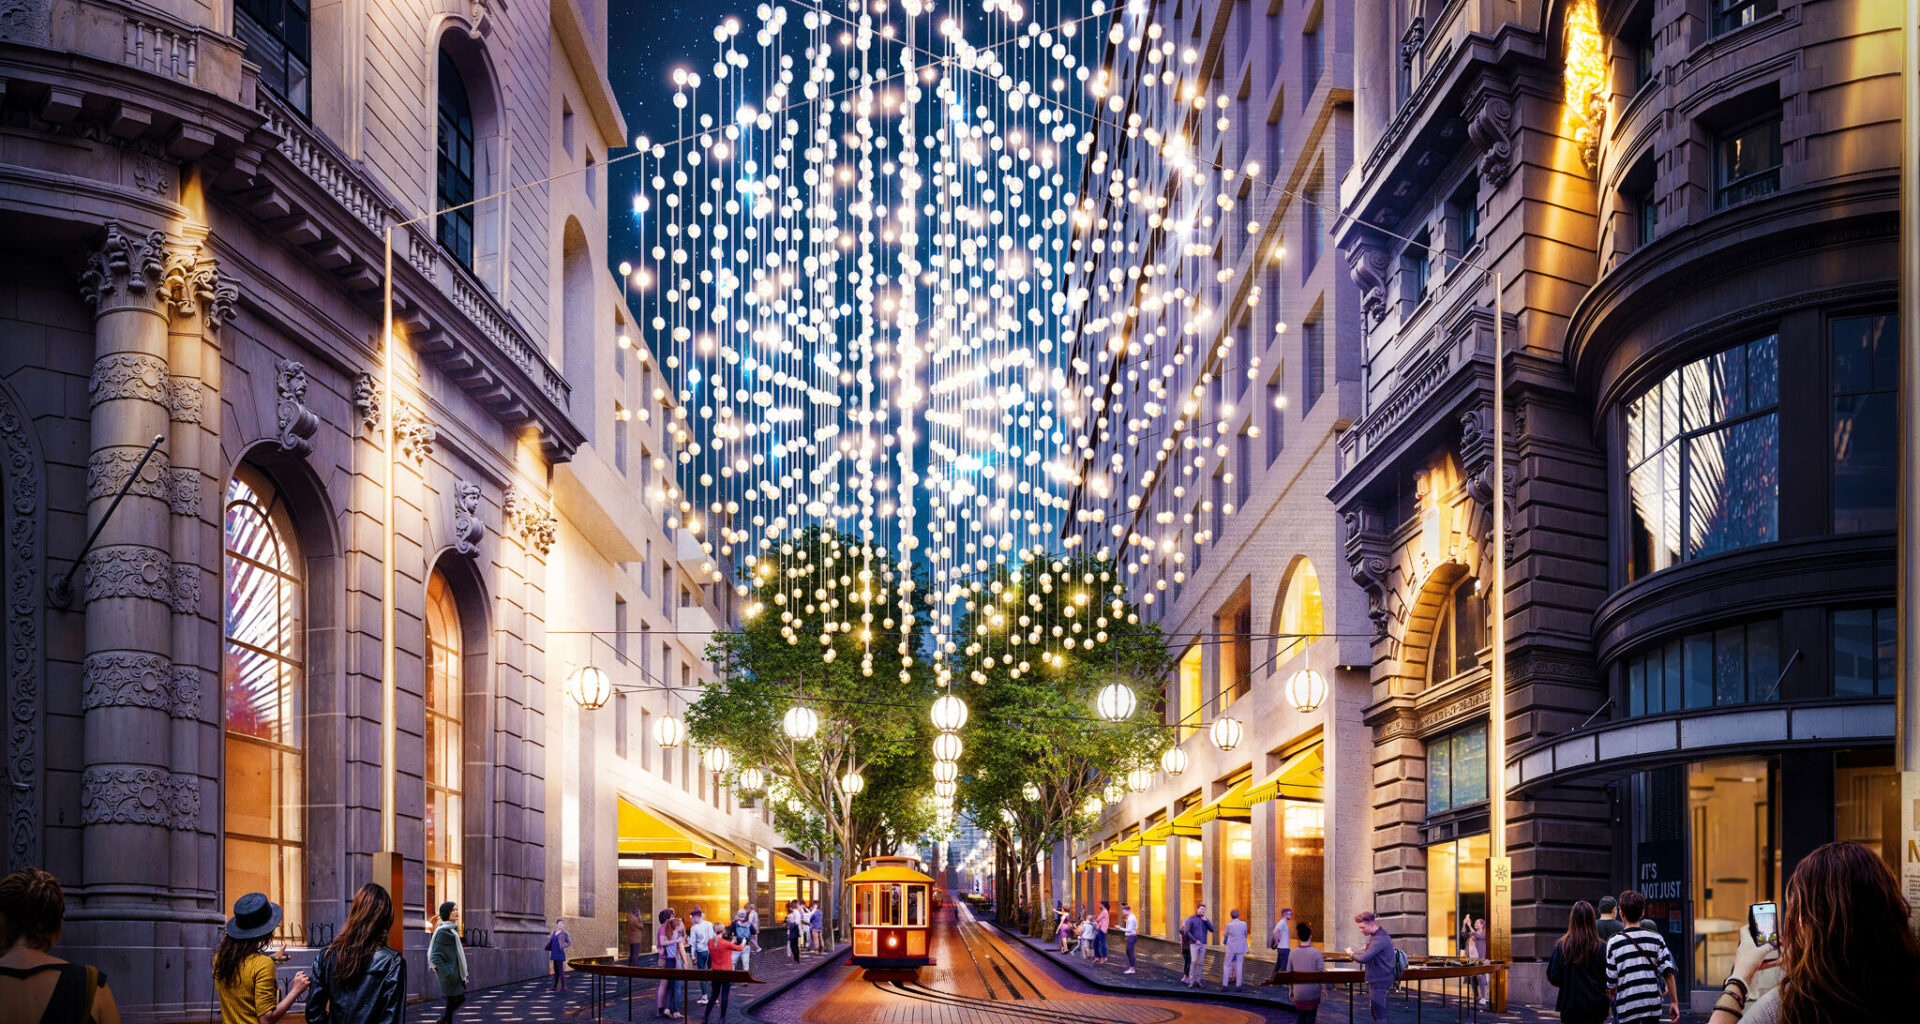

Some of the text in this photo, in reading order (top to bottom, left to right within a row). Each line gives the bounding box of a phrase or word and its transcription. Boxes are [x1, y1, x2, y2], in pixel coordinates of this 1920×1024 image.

[1641, 863, 1657, 880] IT'S
[1641, 880, 1681, 899] NOT JUST
